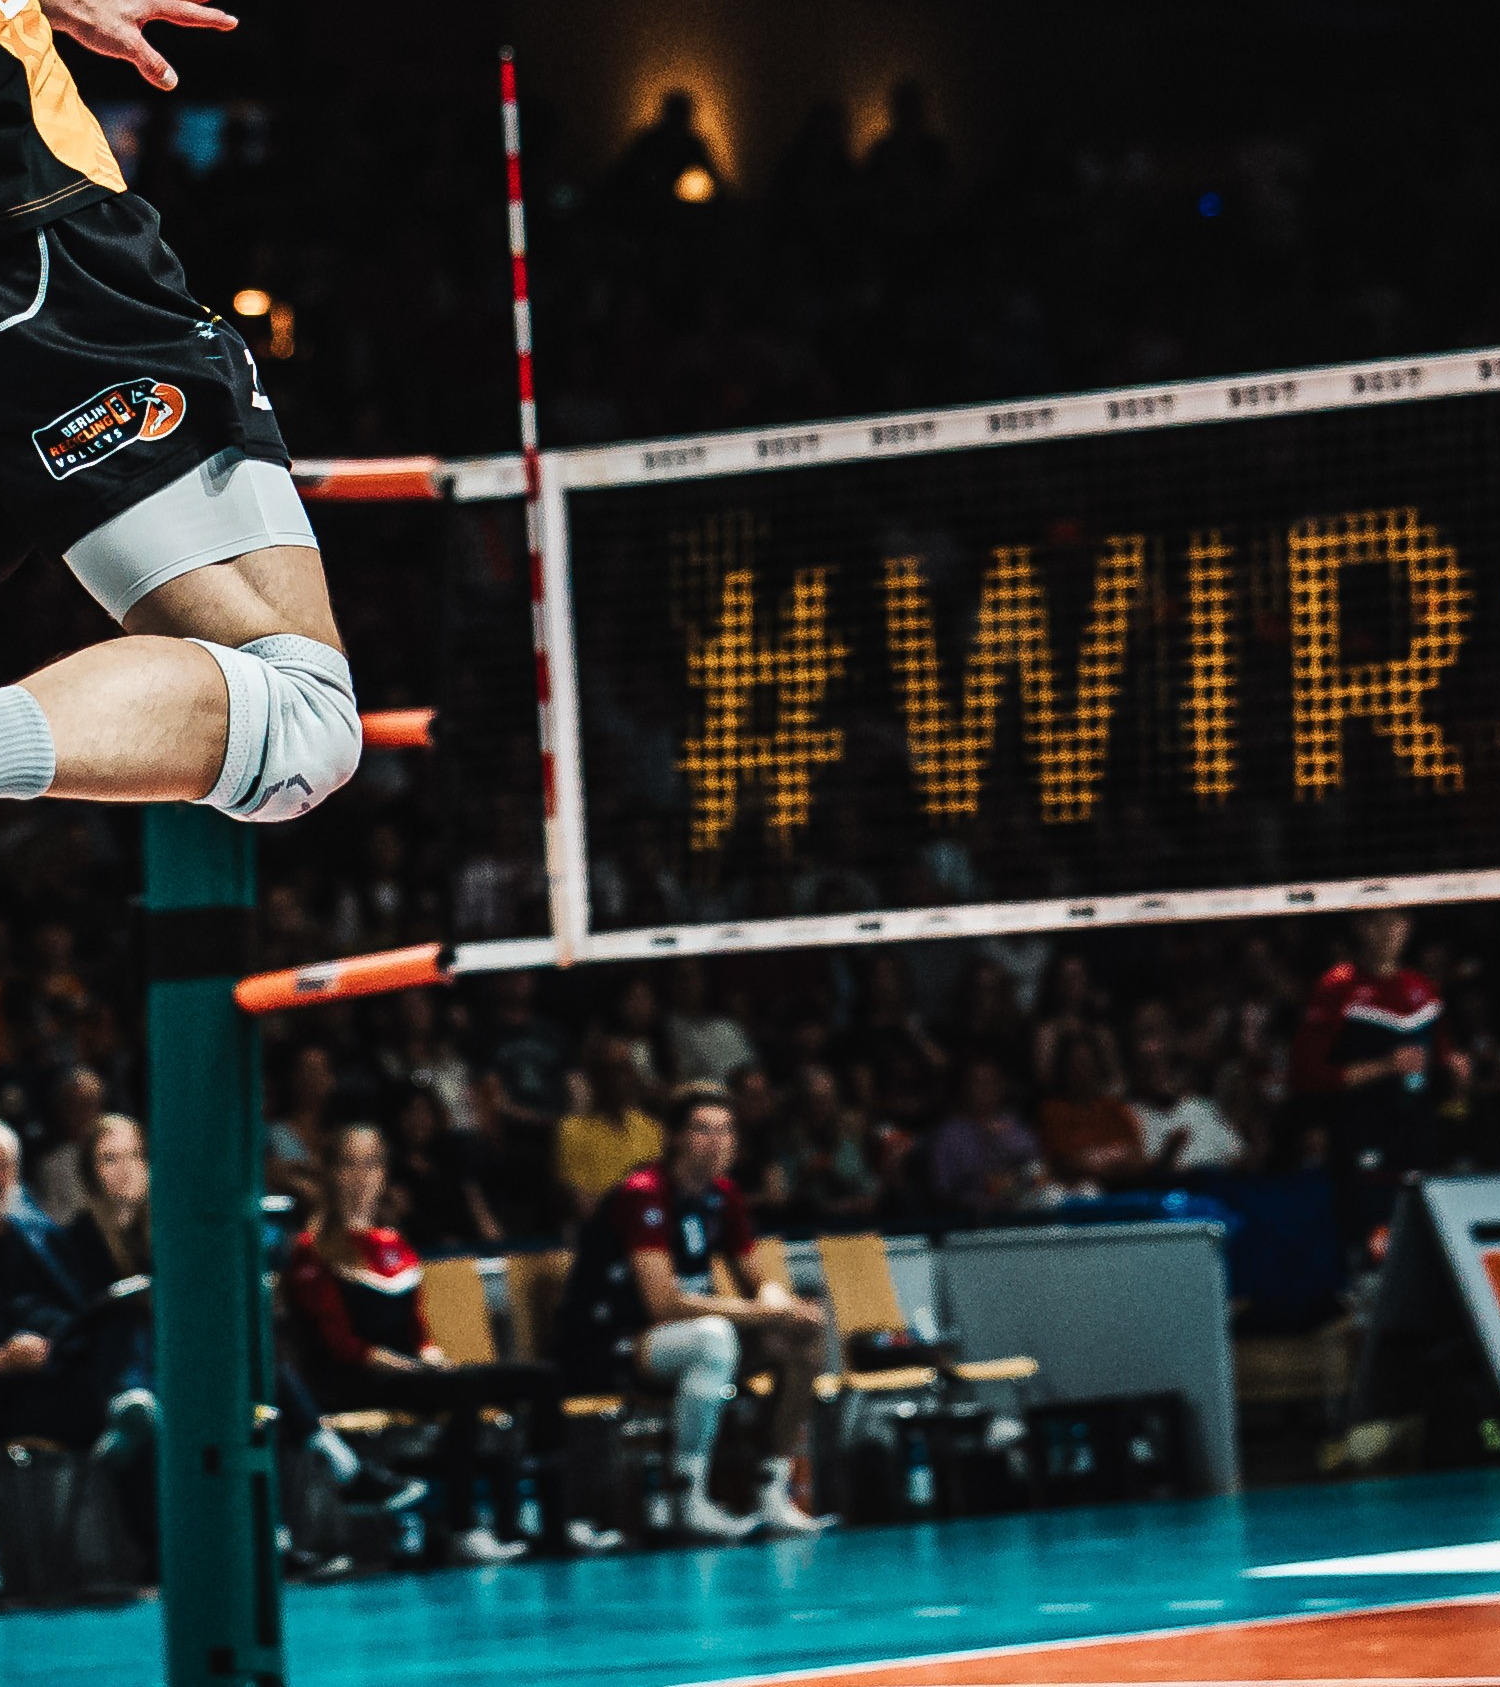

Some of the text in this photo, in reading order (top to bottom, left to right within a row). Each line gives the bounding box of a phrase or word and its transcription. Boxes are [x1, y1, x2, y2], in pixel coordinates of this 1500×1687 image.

[49, 414, 115, 458] RECYCLING
[61, 403, 108, 438] BERLIN
[55, 427, 124, 468] VOLLEYS
